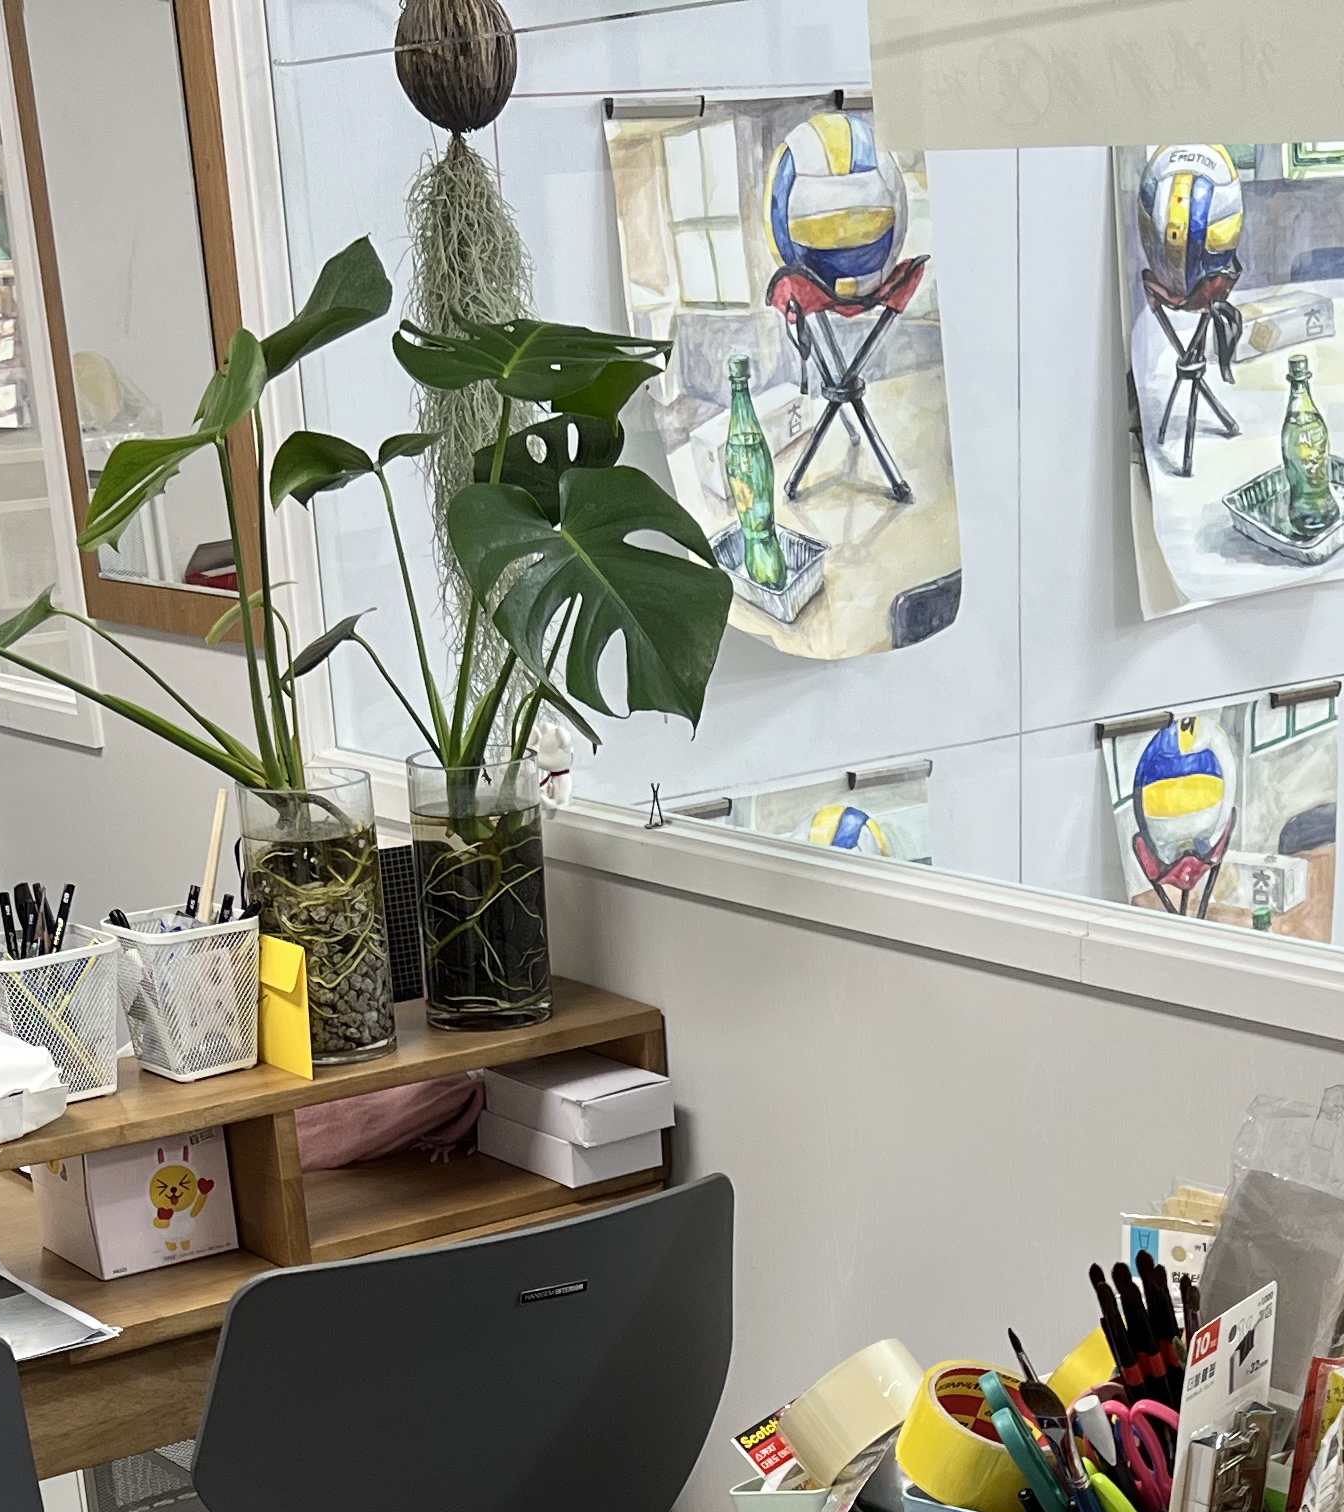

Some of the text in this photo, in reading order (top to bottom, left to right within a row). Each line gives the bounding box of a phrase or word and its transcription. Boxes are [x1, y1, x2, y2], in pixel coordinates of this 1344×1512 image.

[1169, 149, 1217, 170] EMOTION
[1195, 1331, 1211, 1360] 10
[754, 1442, 777, 1462] 스카치
